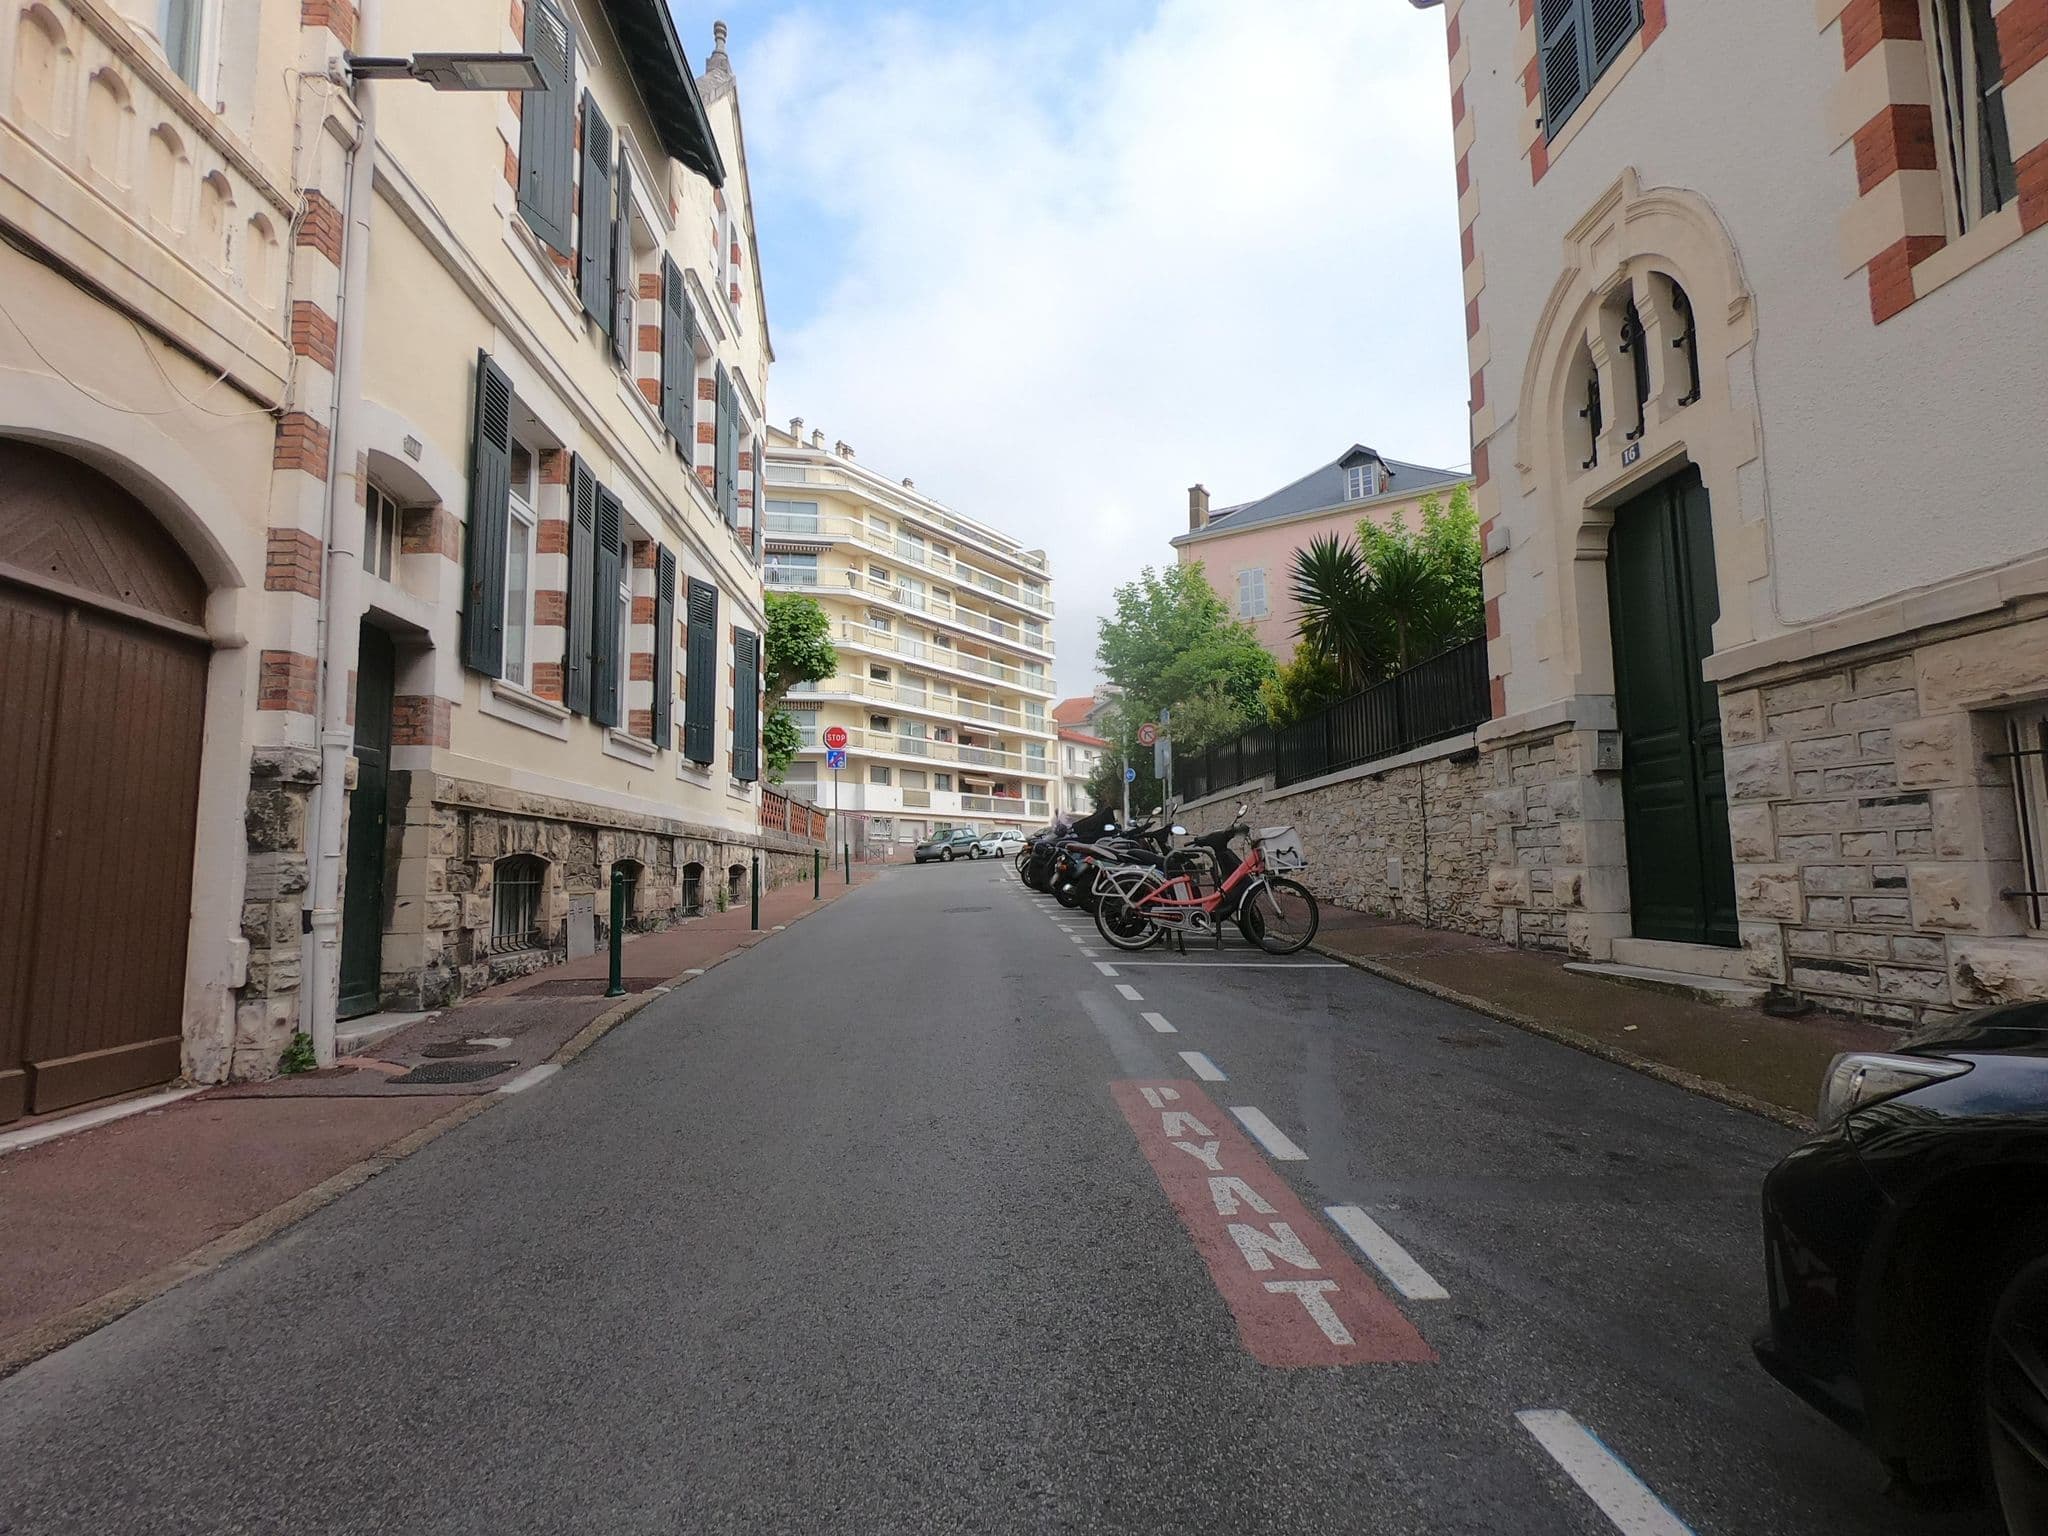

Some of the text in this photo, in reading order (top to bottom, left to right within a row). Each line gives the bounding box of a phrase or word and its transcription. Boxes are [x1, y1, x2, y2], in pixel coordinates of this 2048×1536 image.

[1624, 447, 1636, 464] 16
[827, 734, 846, 742] STOP
[1139, 1086, 1356, 1345] PAYANT
